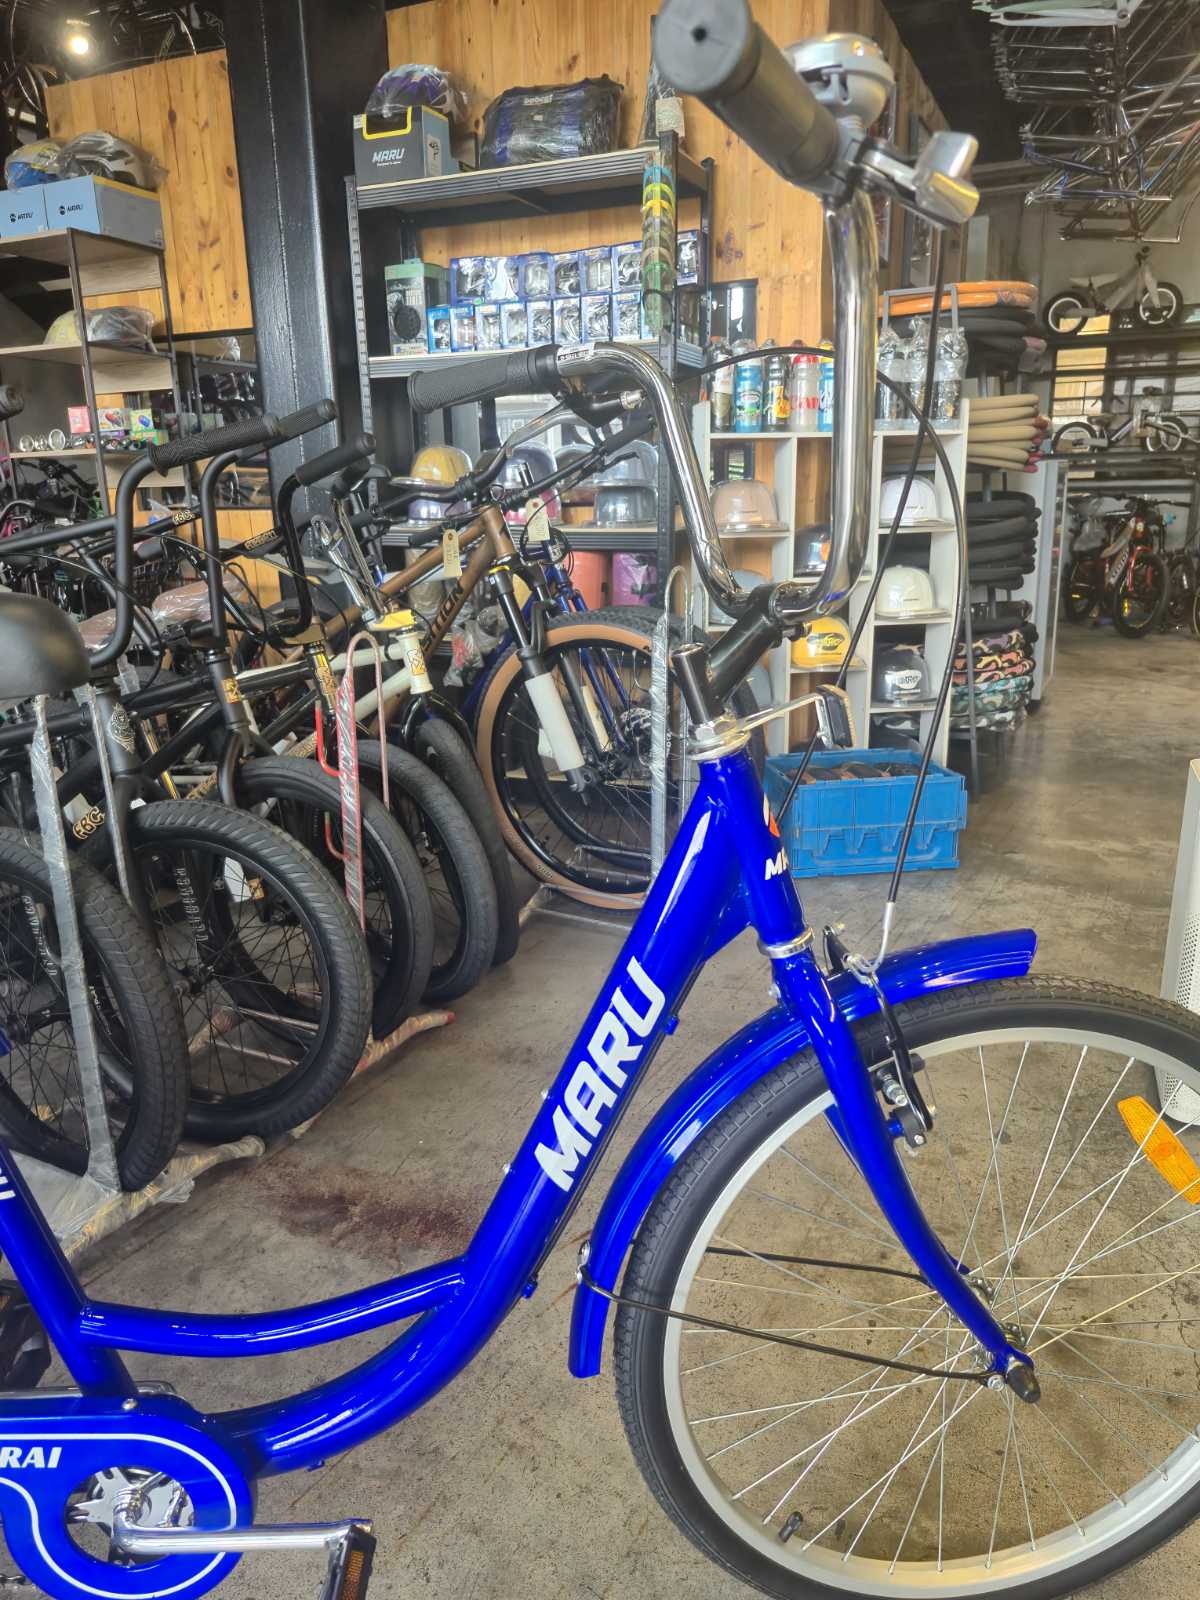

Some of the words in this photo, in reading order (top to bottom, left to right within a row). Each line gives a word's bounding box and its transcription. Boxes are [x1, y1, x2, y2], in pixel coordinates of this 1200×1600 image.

[372, 147, 405, 163] MARU
[534, 955, 666, 1192] MARU
[0, 1446, 63, 1468] RAI
